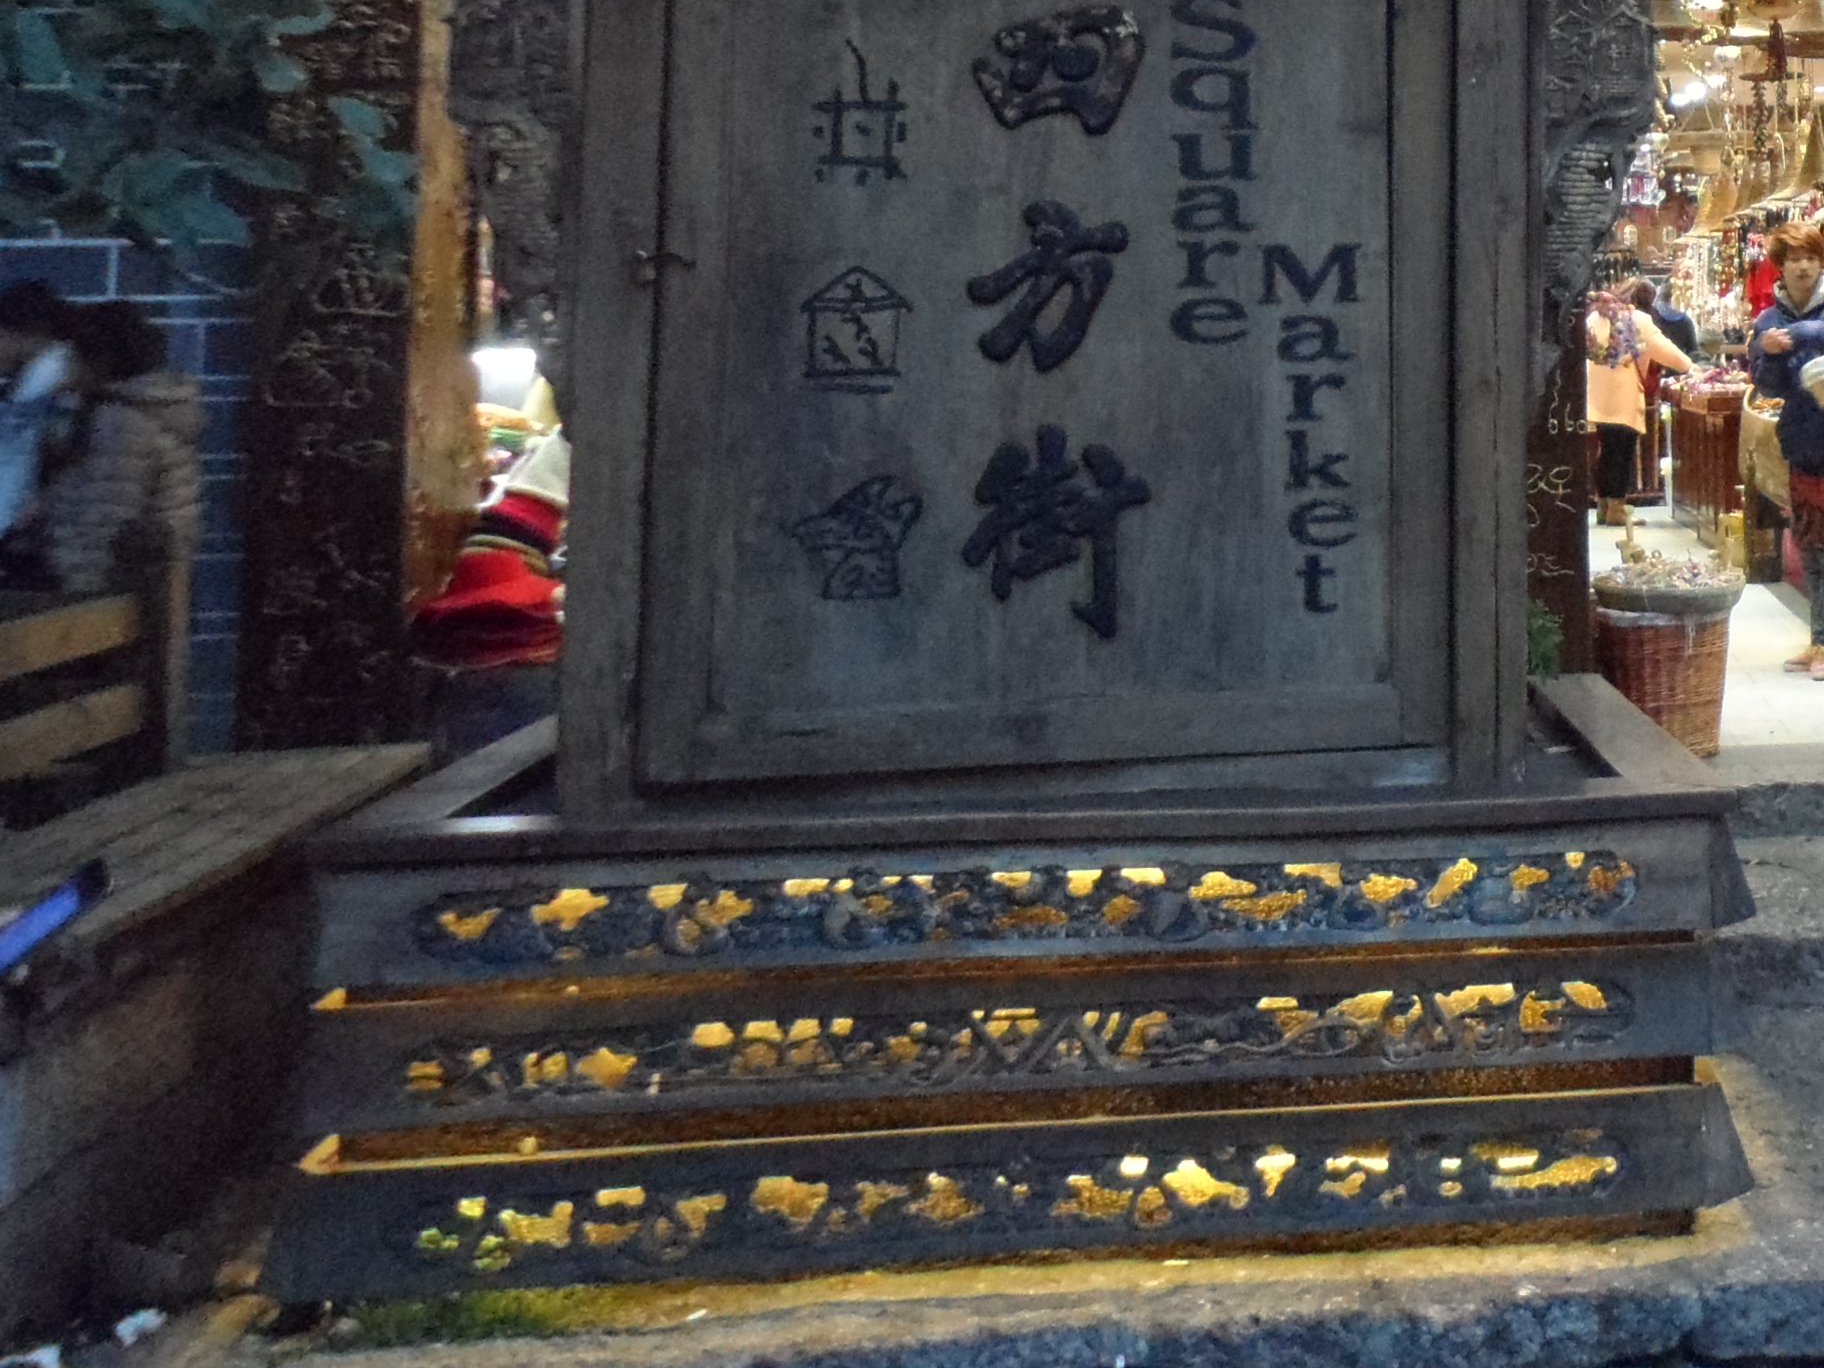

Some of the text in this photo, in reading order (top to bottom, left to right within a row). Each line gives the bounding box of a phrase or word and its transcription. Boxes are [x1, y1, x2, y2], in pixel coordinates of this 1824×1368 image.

[961, 4, 1153, 640] 四方街
[1256, 241, 1363, 616] Market
